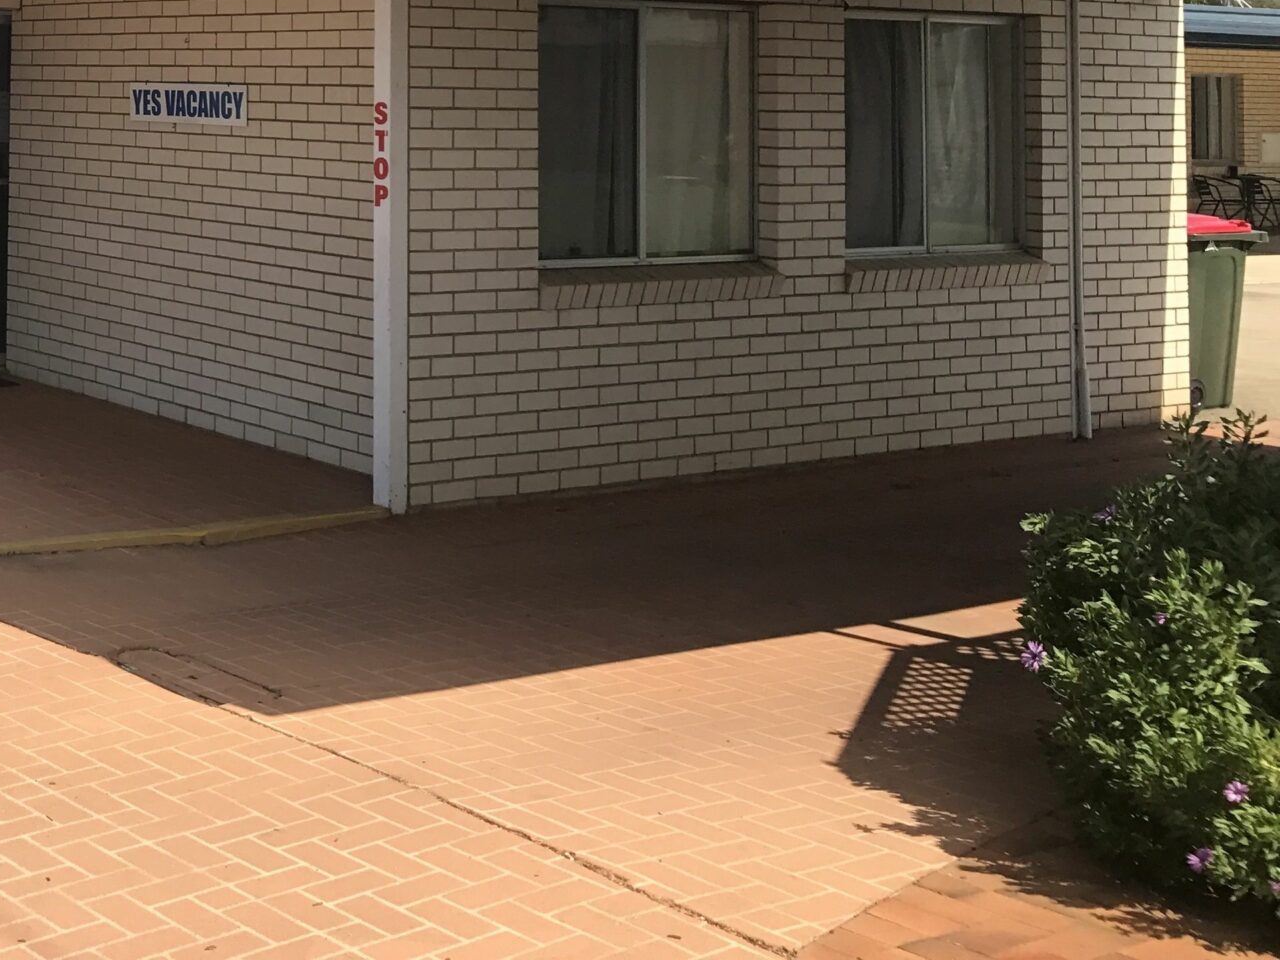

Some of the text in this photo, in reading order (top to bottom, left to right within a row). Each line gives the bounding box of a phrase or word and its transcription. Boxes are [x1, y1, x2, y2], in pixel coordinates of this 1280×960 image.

[132, 89, 244, 120] YES VACANCY
[373, 102, 389, 207] STOP
